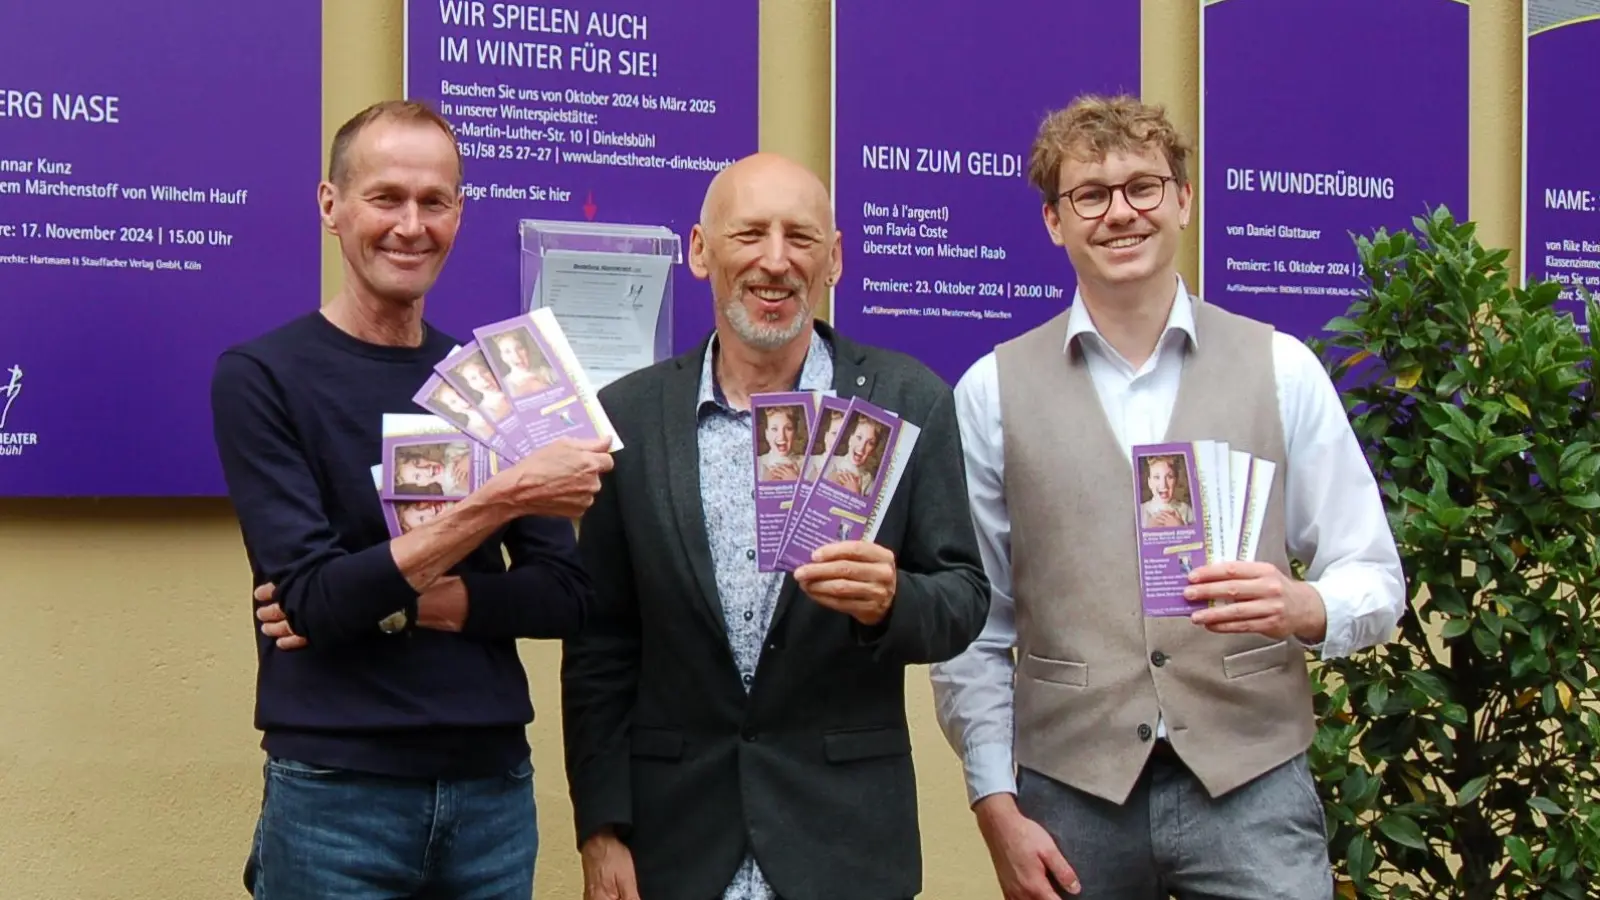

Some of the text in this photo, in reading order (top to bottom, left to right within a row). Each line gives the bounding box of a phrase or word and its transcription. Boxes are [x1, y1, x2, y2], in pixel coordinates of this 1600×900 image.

[439, 0, 647, 41] WIR SPIELEN AUCH
[440, 36, 657, 78] IM WINTER FÜR SIE!
[0, 89, 120, 124] ERG NASE
[441, 79, 717, 114] Besuchen Sie uns von Oktober 2024 bis März 2025
[440, 99, 598, 126] in unserer Winterspielstätte:
[569, 129, 584, 144] 10
[592, 131, 656, 148] Dinkelsbühl
[498, 144, 514, 160] 25
[862, 144, 1022, 178] NEIN ZUM GELD!
[0, 157, 72, 175] nnar Kunz
[0, 178, 248, 205] em Märchenstoff von Wilhelm Hauff
[460, 182, 572, 202] räge finden Sie hier
[1226, 168, 1394, 200] DIE WUNDERÜBUNG
[863, 201, 890, 218] (Non
[1545, 187, 1596, 212] NAME:
[0, 224, 16, 237] re:
[21, 222, 42, 239] 17.
[45, 222, 117, 241] November
[119, 226, 154, 243] 2024
[168, 229, 205, 245] 15.00
[208, 229, 233, 246] Uhr
[863, 222, 949, 239] von Flavia Coste
[1226, 223, 1321, 240] von Daniel Glattauer
[863, 240, 1007, 260] übersetzt von Michael Raab
[1545, 241, 1562, 251] von
[0, 253, 29, 264] rechte:
[29, 254, 71, 266] Hartmann
[80, 256, 128, 268] Stauffacher
[128, 258, 155, 271] Verlag
[183, 260, 202, 270] Köln
[1226, 257, 1271, 272] Premiere:
[1273, 260, 1287, 273] 16.
[1288, 259, 1326, 274] Oktober
[1327, 262, 1350, 275] 2024
[1545, 254, 1600, 270] Klassenzimme
[863, 277, 913, 293] Premiere:
[915, 280, 932, 294] 23.
[933, 279, 976, 296] Oktober
[978, 282, 1004, 297] 2024
[1014, 284, 1043, 298] 20.00
[1044, 284, 1064, 299] Uhr
[1570, 271, 1584, 287] Sie
[1584, 276, 1600, 286] uns
[0, 445, 23, 456] bühl
